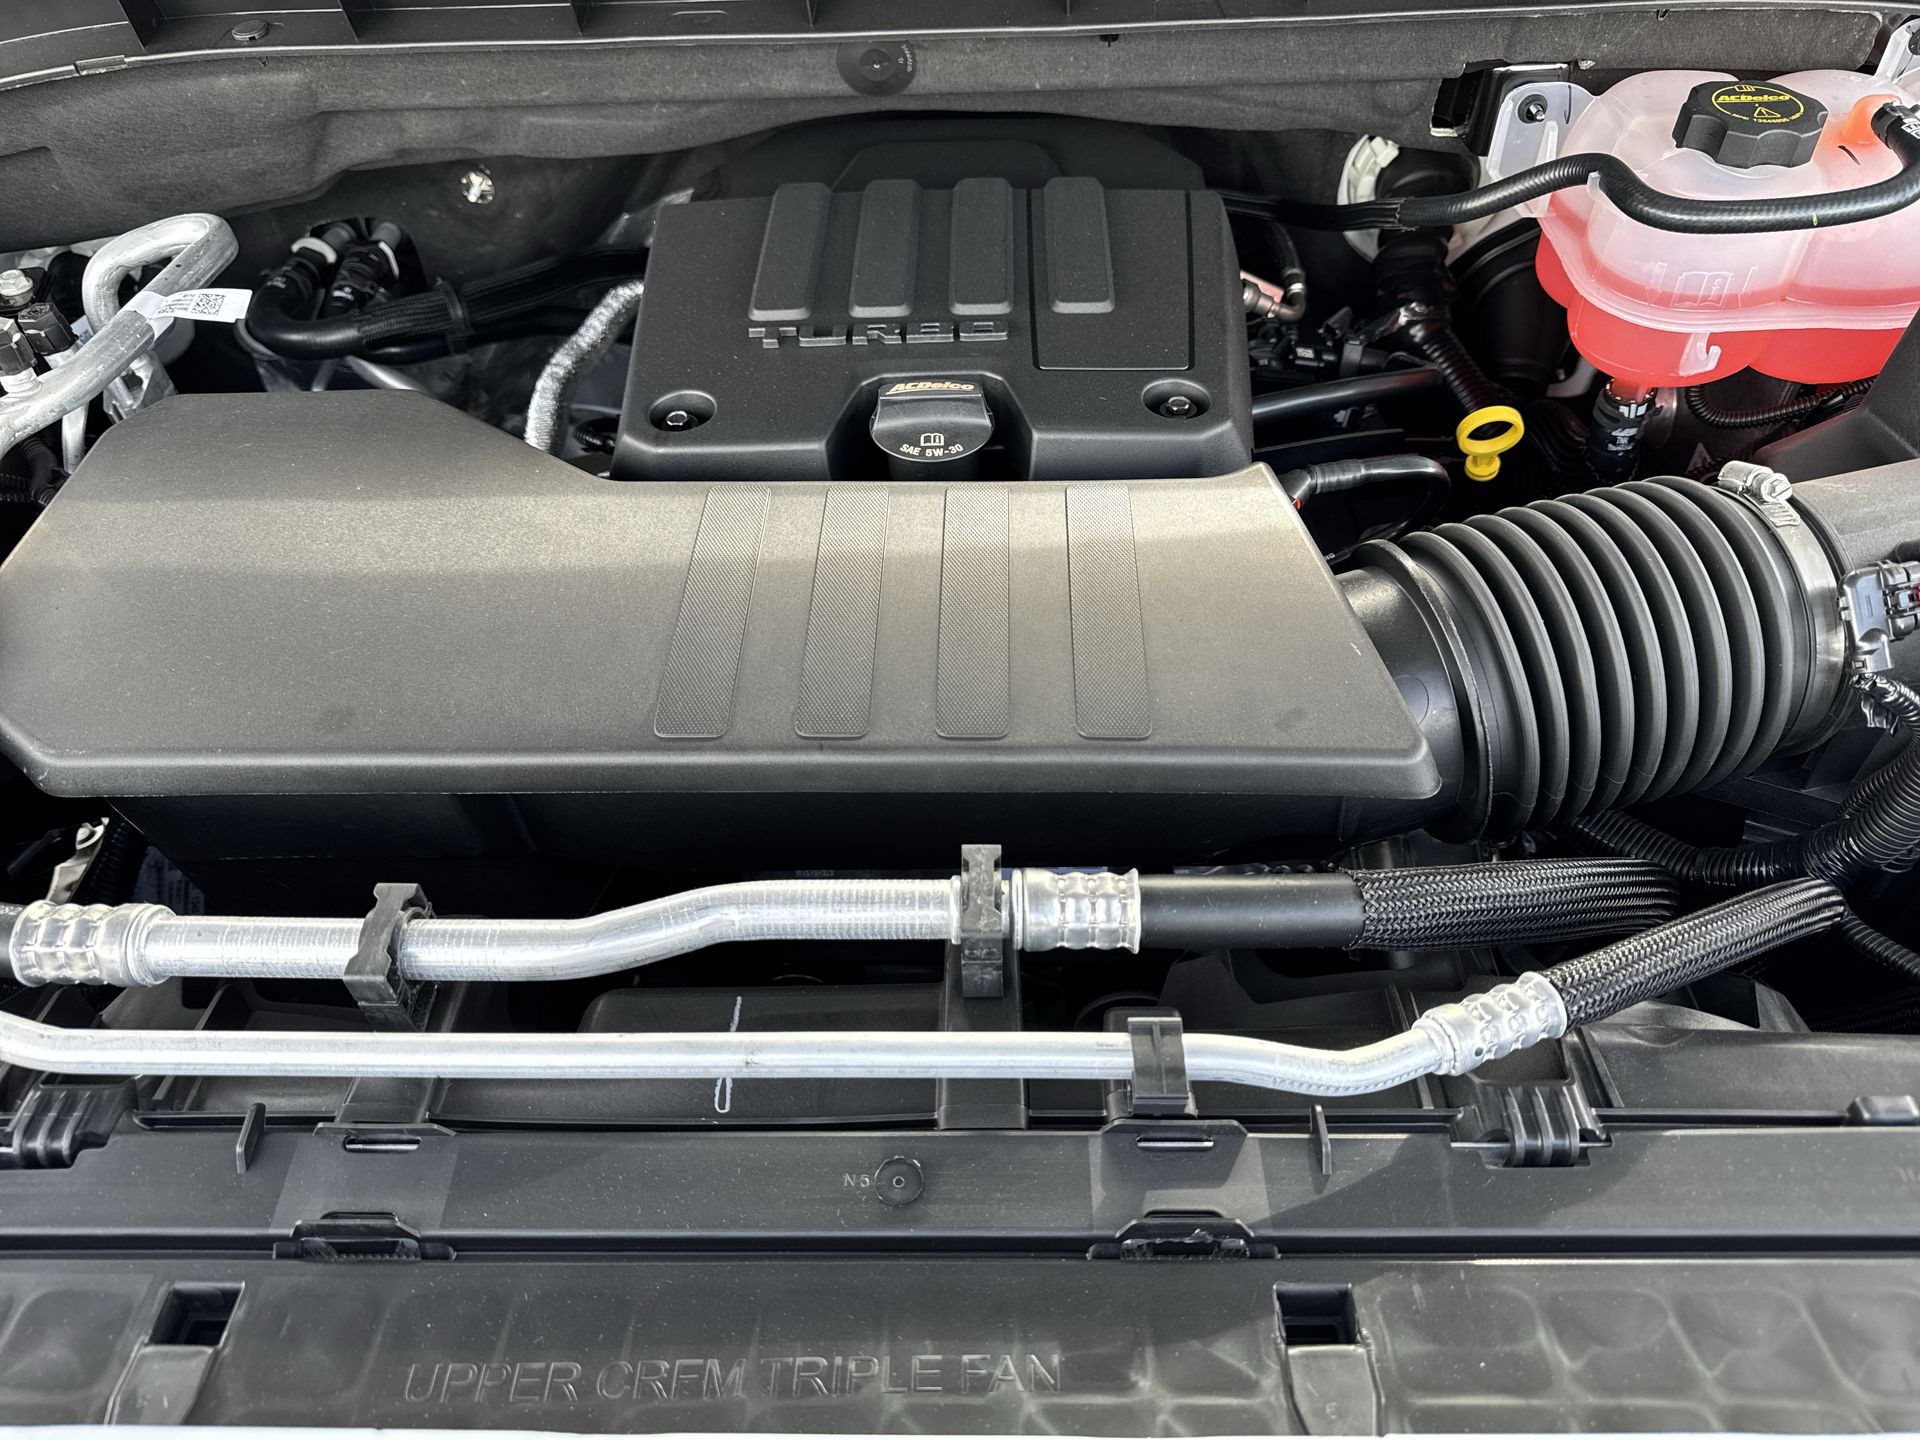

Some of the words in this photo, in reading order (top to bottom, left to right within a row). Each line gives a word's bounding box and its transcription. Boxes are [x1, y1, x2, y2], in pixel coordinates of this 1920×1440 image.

[1716, 94, 1790, 103] ACDelco
[885, 381, 975, 395] ACDelco
[899, 443, 921, 456] SAE
[925, 443, 964, 457] 5W-30
[404, 1361, 582, 1403] UPPER
[596, 1357, 748, 1401] CRFM
[760, 1355, 943, 1397] TRIPLE
[960, 1353, 1062, 1396] FAN
